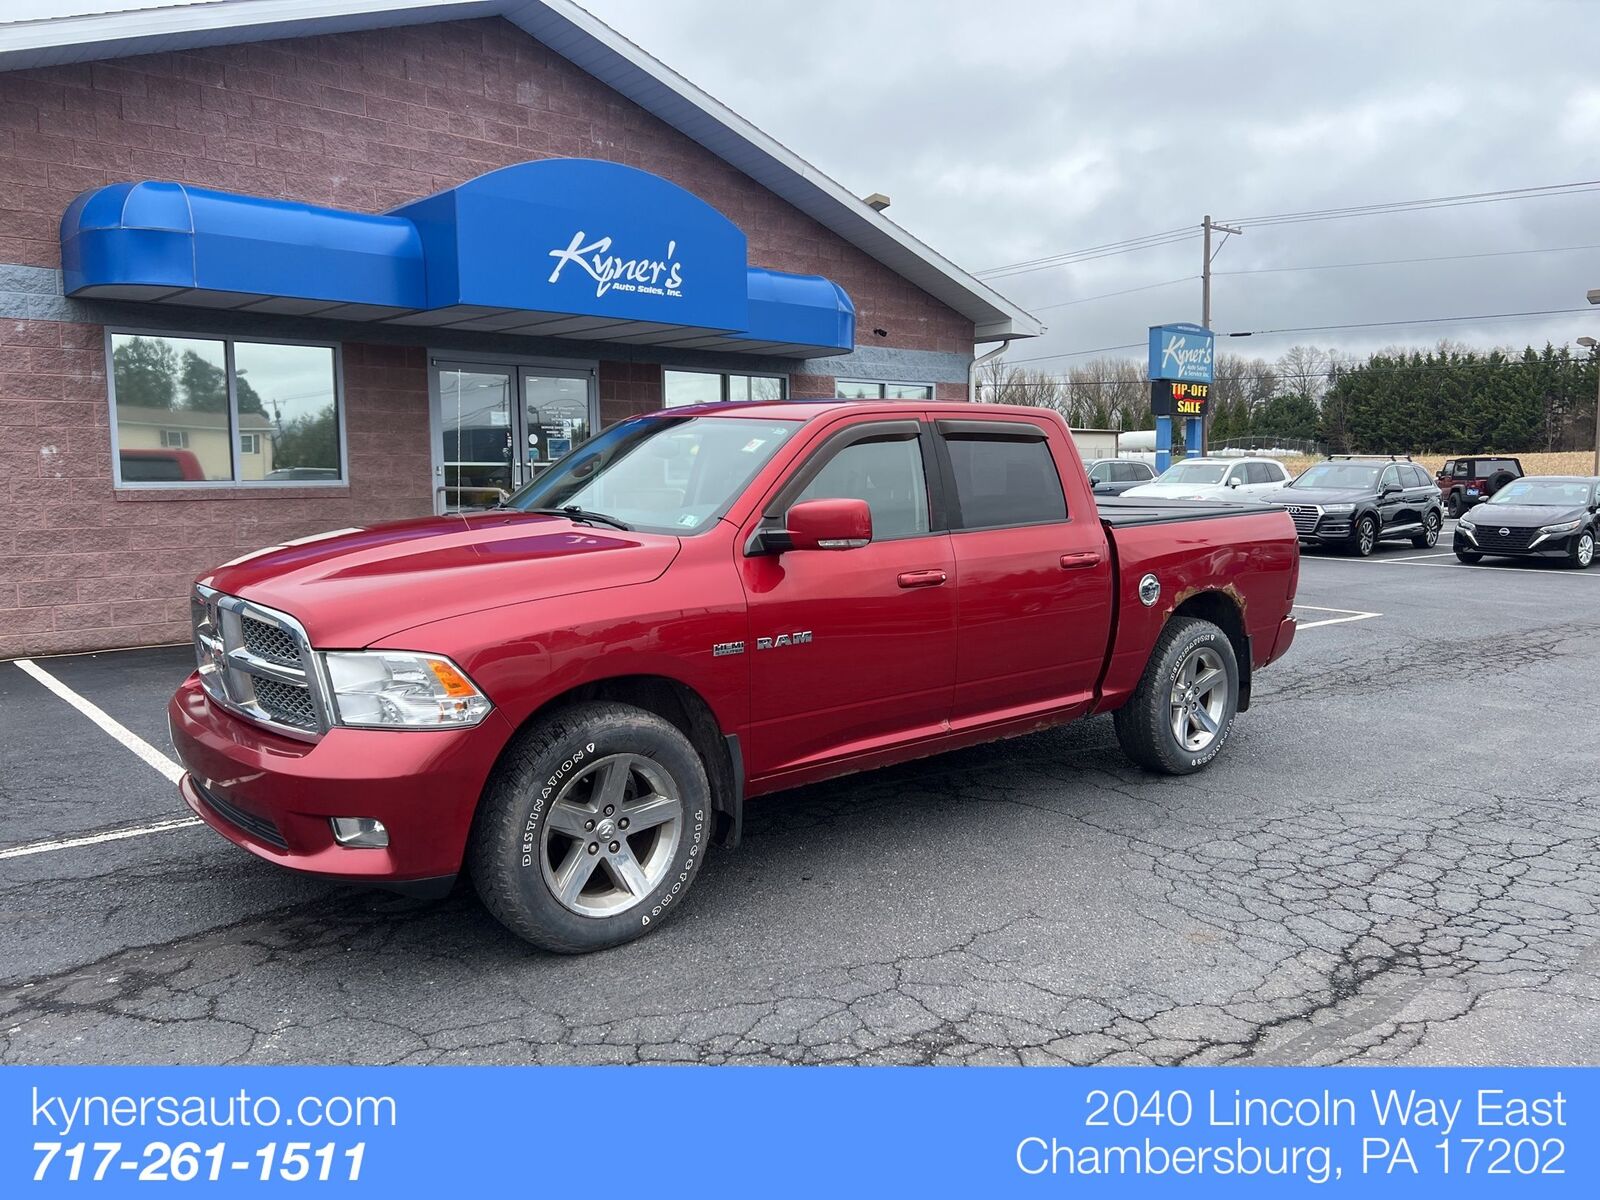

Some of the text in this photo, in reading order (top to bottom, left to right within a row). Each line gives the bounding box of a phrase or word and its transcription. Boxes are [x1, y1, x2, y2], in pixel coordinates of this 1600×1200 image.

[548, 231, 682, 298] Kyner's
[612, 282, 683, 297] Auto Sales, Inc.
[1162, 336, 1211, 378] Kyner's
[1171, 383, 1208, 397] TIP-OFF
[1177, 400, 1201, 413] SALE
[757, 631, 812, 650] RAM
[522, 750, 585, 868] DESTINATION
